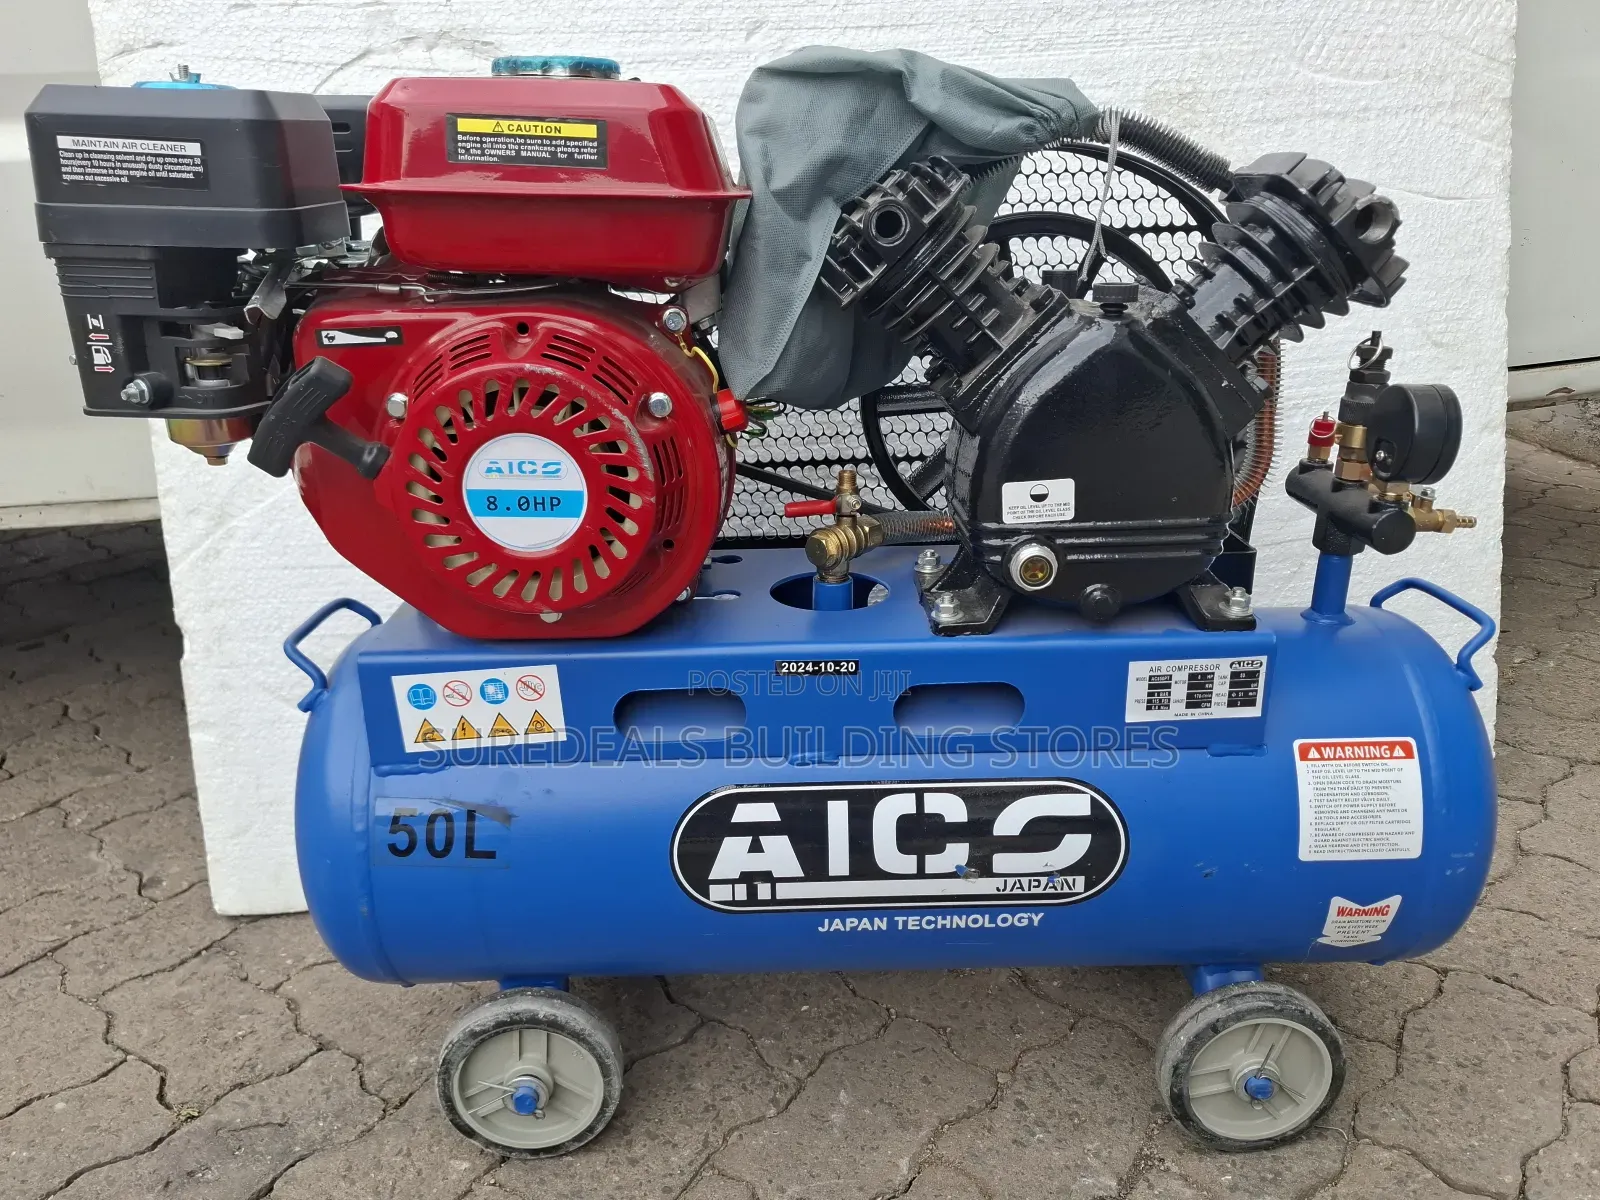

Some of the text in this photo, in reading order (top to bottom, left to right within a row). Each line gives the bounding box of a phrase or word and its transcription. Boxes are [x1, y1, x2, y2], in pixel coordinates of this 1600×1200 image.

[508, 124, 562, 134] CAUTION
[72, 139, 188, 152] MAINTAIN AIR CLEANER
[90, 152, 115, 162] cleansing
[146, 155, 156, 164] dry
[178, 158, 193, 166] every
[148, 163, 163, 171] dusty
[130, 170, 148, 178] engine
[485, 460, 562, 475] AICS
[486, 496, 562, 512] 8.0HP
[781, 662, 856, 673] 2024-10-20
[1166, 664, 1221, 673] COMPRESSOR
[1320, 745, 1390, 758] WARNING
[388, 808, 496, 860] 50L
[708, 792, 1092, 880] AICS
[996, 877, 1076, 893] JAPAN
[1336, 904, 1390, 917] WARNING
[818, 912, 1044, 932] JAPAN TECHNOLOGY
